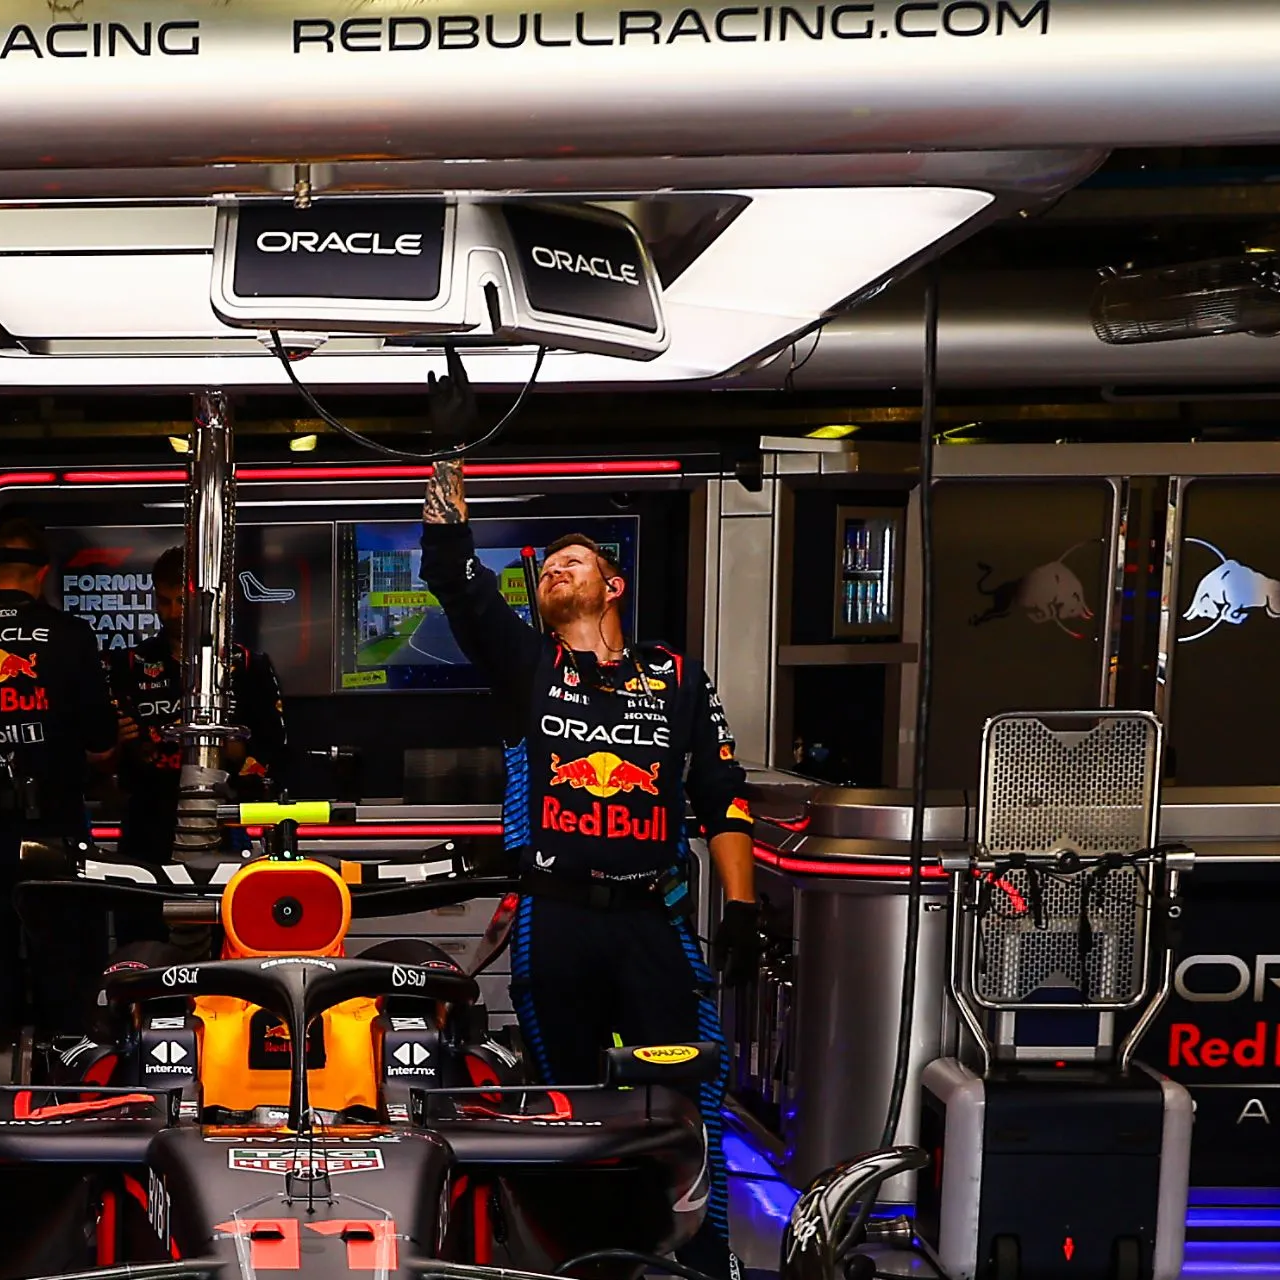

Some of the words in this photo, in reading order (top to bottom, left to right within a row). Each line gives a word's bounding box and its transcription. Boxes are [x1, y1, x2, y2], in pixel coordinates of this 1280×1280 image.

[292, 0, 1051, 53] REDBULLRACING.COM
[257, 231, 422, 255] ORACLE
[531, 245, 640, 286] ORACLE
[63, 573, 154, 592] FORMU
[63, 595, 153, 612] PIRELLI
[73, 613, 133, 631] RAN
[0, 685, 51, 713] Bull
[624, 712, 668, 723] HONDA
[541, 714, 670, 748] ORACLE
[542, 796, 602, 836] Red
[607, 803, 667, 841] Bull
[1168, 1022, 1268, 1067] Red
[145, 1063, 193, 1075] inter.mx
[387, 1066, 436, 1077] inter.mx
[233, 1150, 377, 1159] TAG
[236, 1158, 375, 1170] HEUER
